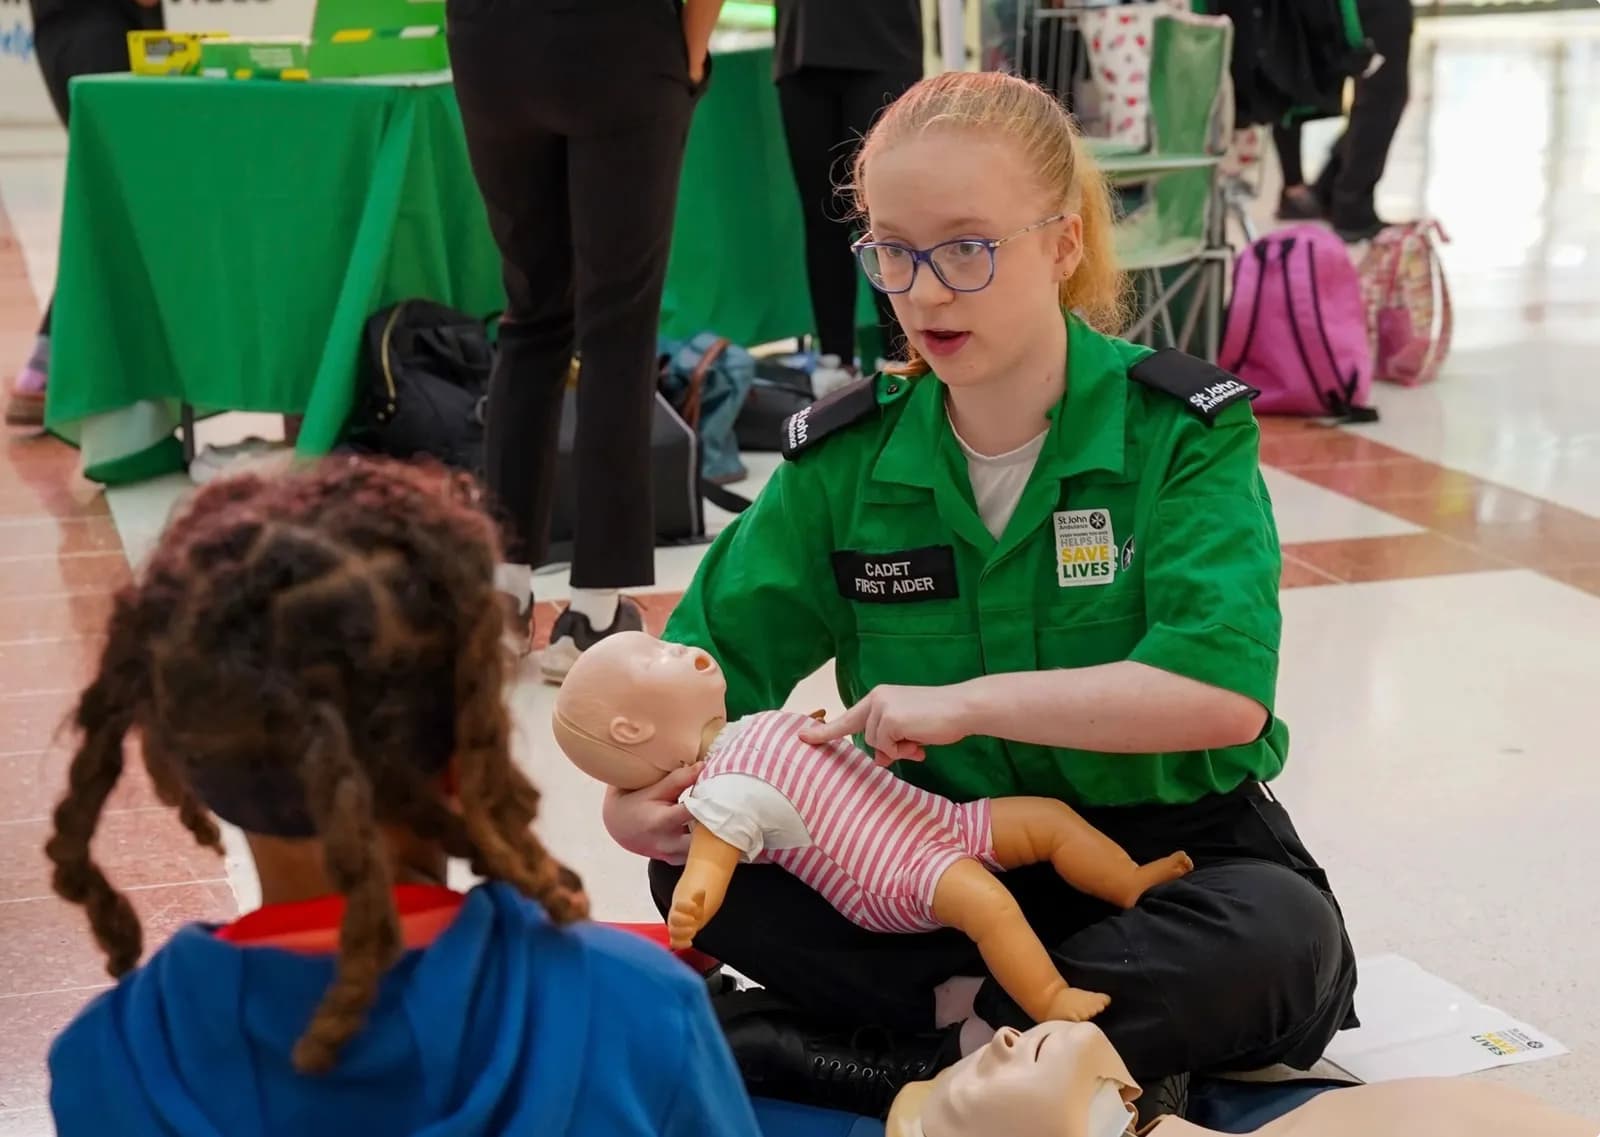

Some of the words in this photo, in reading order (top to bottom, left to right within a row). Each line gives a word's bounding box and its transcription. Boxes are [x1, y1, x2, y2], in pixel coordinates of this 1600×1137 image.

[1189, 392, 1210, 407] St
[1204, 380, 1239, 398] John
[1057, 516, 1067, 525] St
[1068, 515, 1088, 524] John
[1060, 536, 1093, 547] HELPS
[1095, 535, 1109, 545] US
[1061, 545, 1110, 563] SAVE
[865, 561, 911, 577] CADET
[1063, 562, 1110, 579] LIVES
[855, 577, 886, 595] FIRST
[892, 577, 935, 594] AIDER
